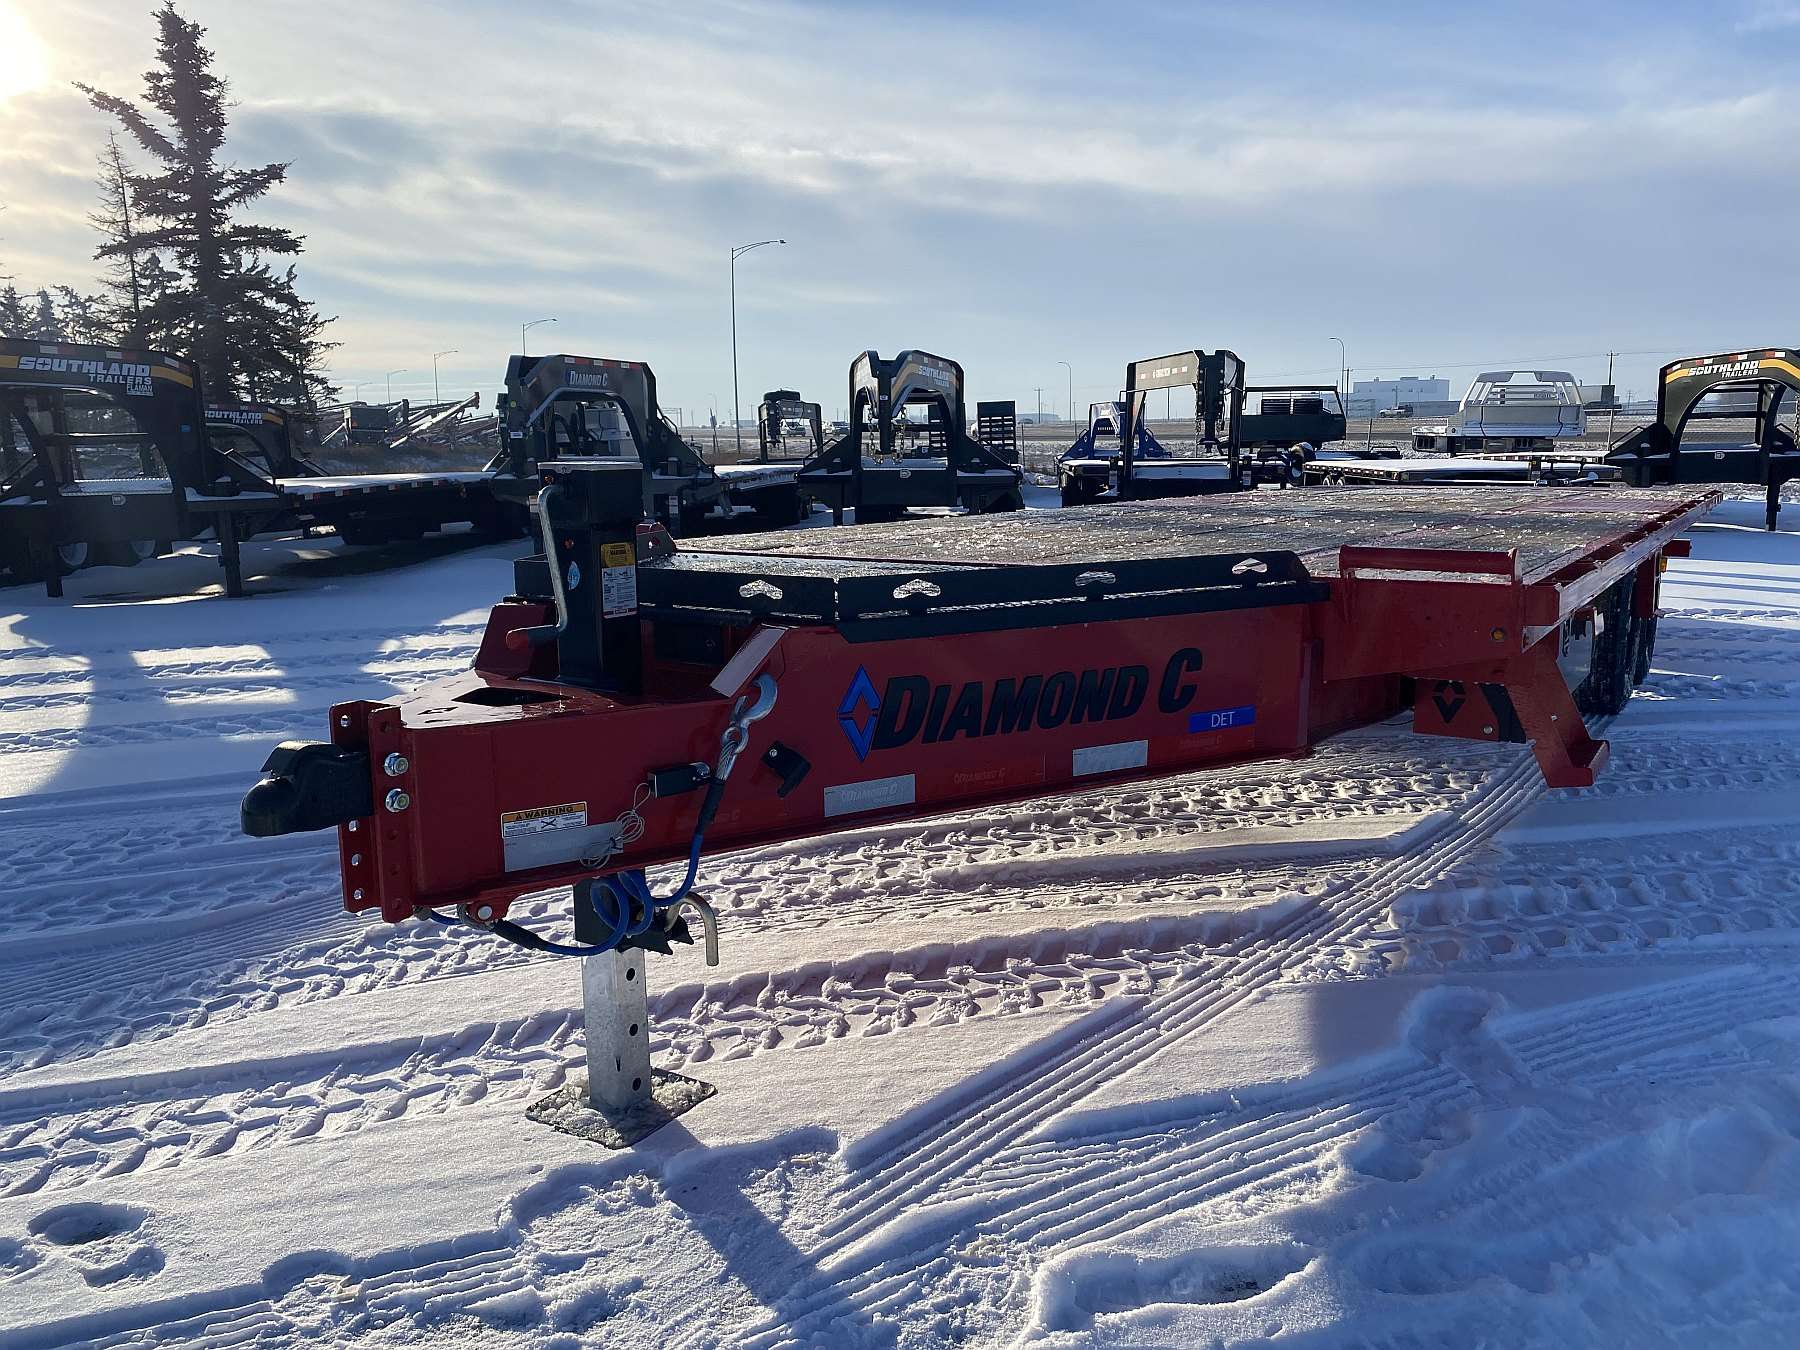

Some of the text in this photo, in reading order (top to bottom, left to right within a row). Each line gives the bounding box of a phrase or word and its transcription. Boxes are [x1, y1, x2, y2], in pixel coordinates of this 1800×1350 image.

[19, 356, 150, 377] SOUTHLAND
[1689, 360, 1760, 376] SOUTHLAND
[1721, 368, 1759, 378] TRAILERS
[89, 373, 152, 385] TRAILERS
[569, 370, 608, 386] DIAMOND C
[127, 383, 153, 392] FLAMAN
[870, 647, 1203, 750] DIAMOND C
[1211, 711, 1236, 728] DET
[525, 805, 574, 819] WARNING
